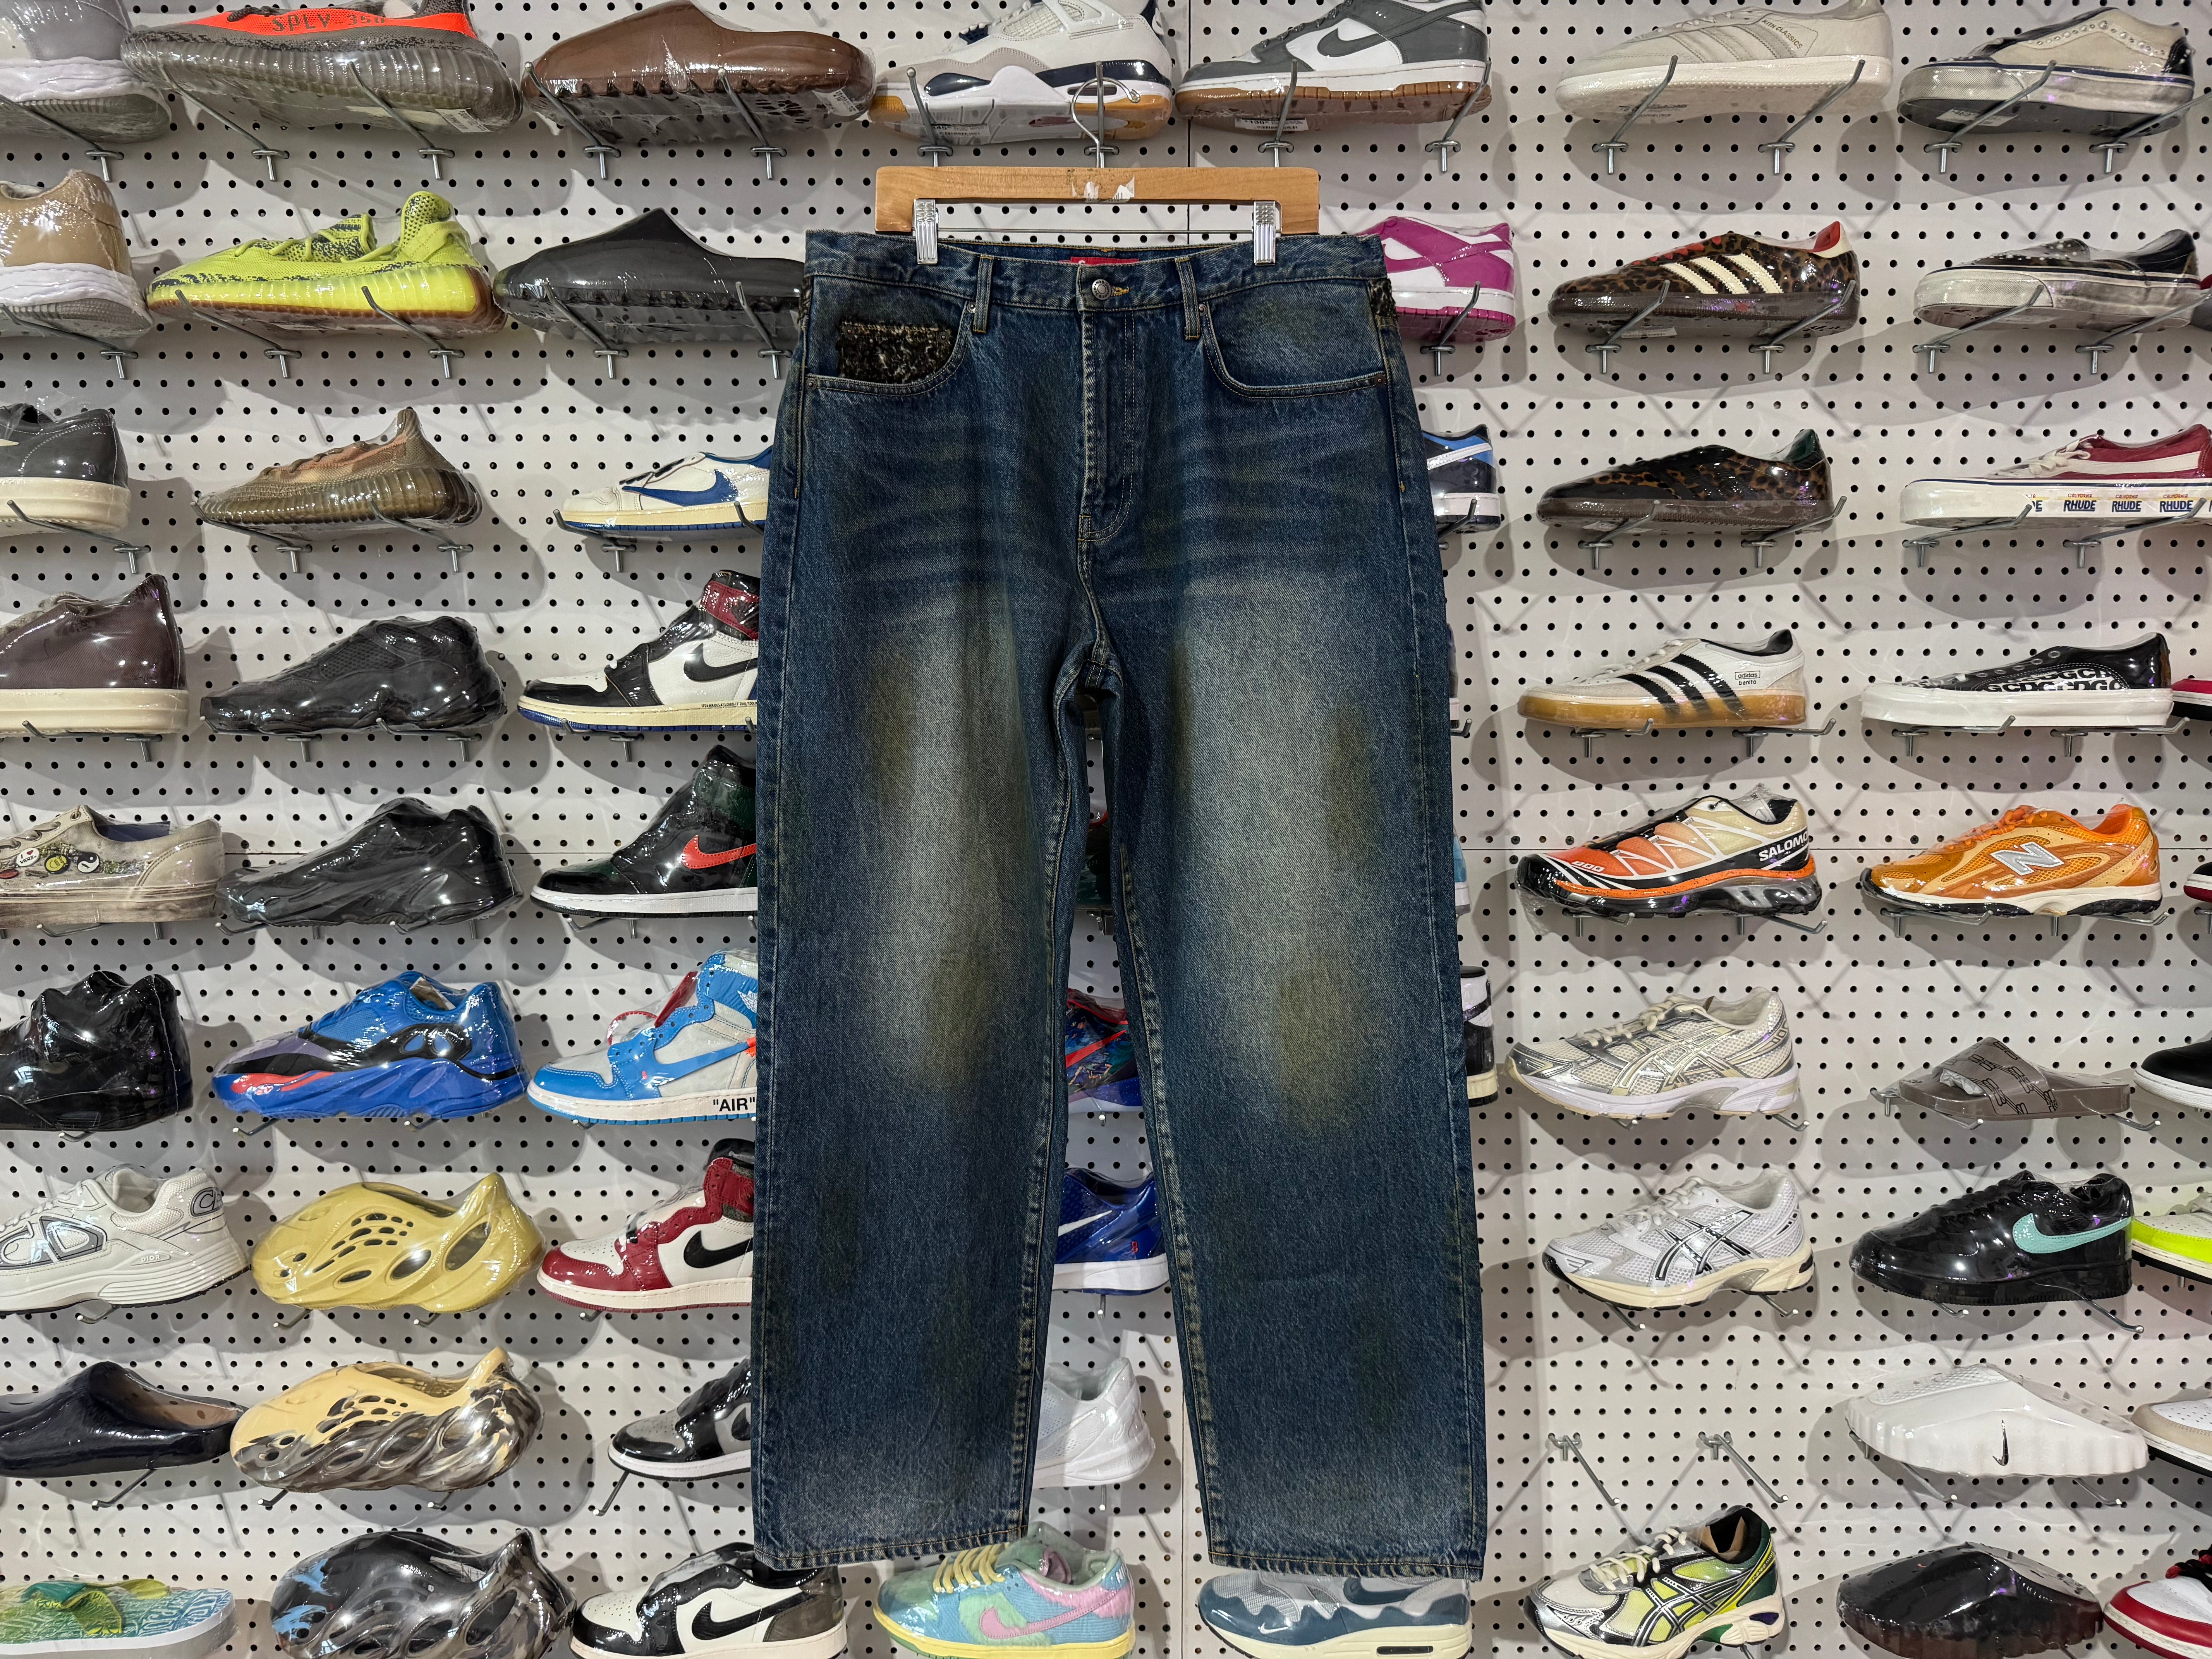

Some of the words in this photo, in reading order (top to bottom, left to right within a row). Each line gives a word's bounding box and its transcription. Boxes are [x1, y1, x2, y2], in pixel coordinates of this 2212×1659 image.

[1776, 27, 1803, 49] CLASSICS
[2064, 500, 2097, 512] RHUDE
[2112, 500, 2142, 512] RHUDE
[2160, 500, 2193, 512] RHUDE
[20, 855, 34, 864] VANS
[713, 1097, 755, 1111] "AIR"
[141, 1254, 160, 1262] DIOR
